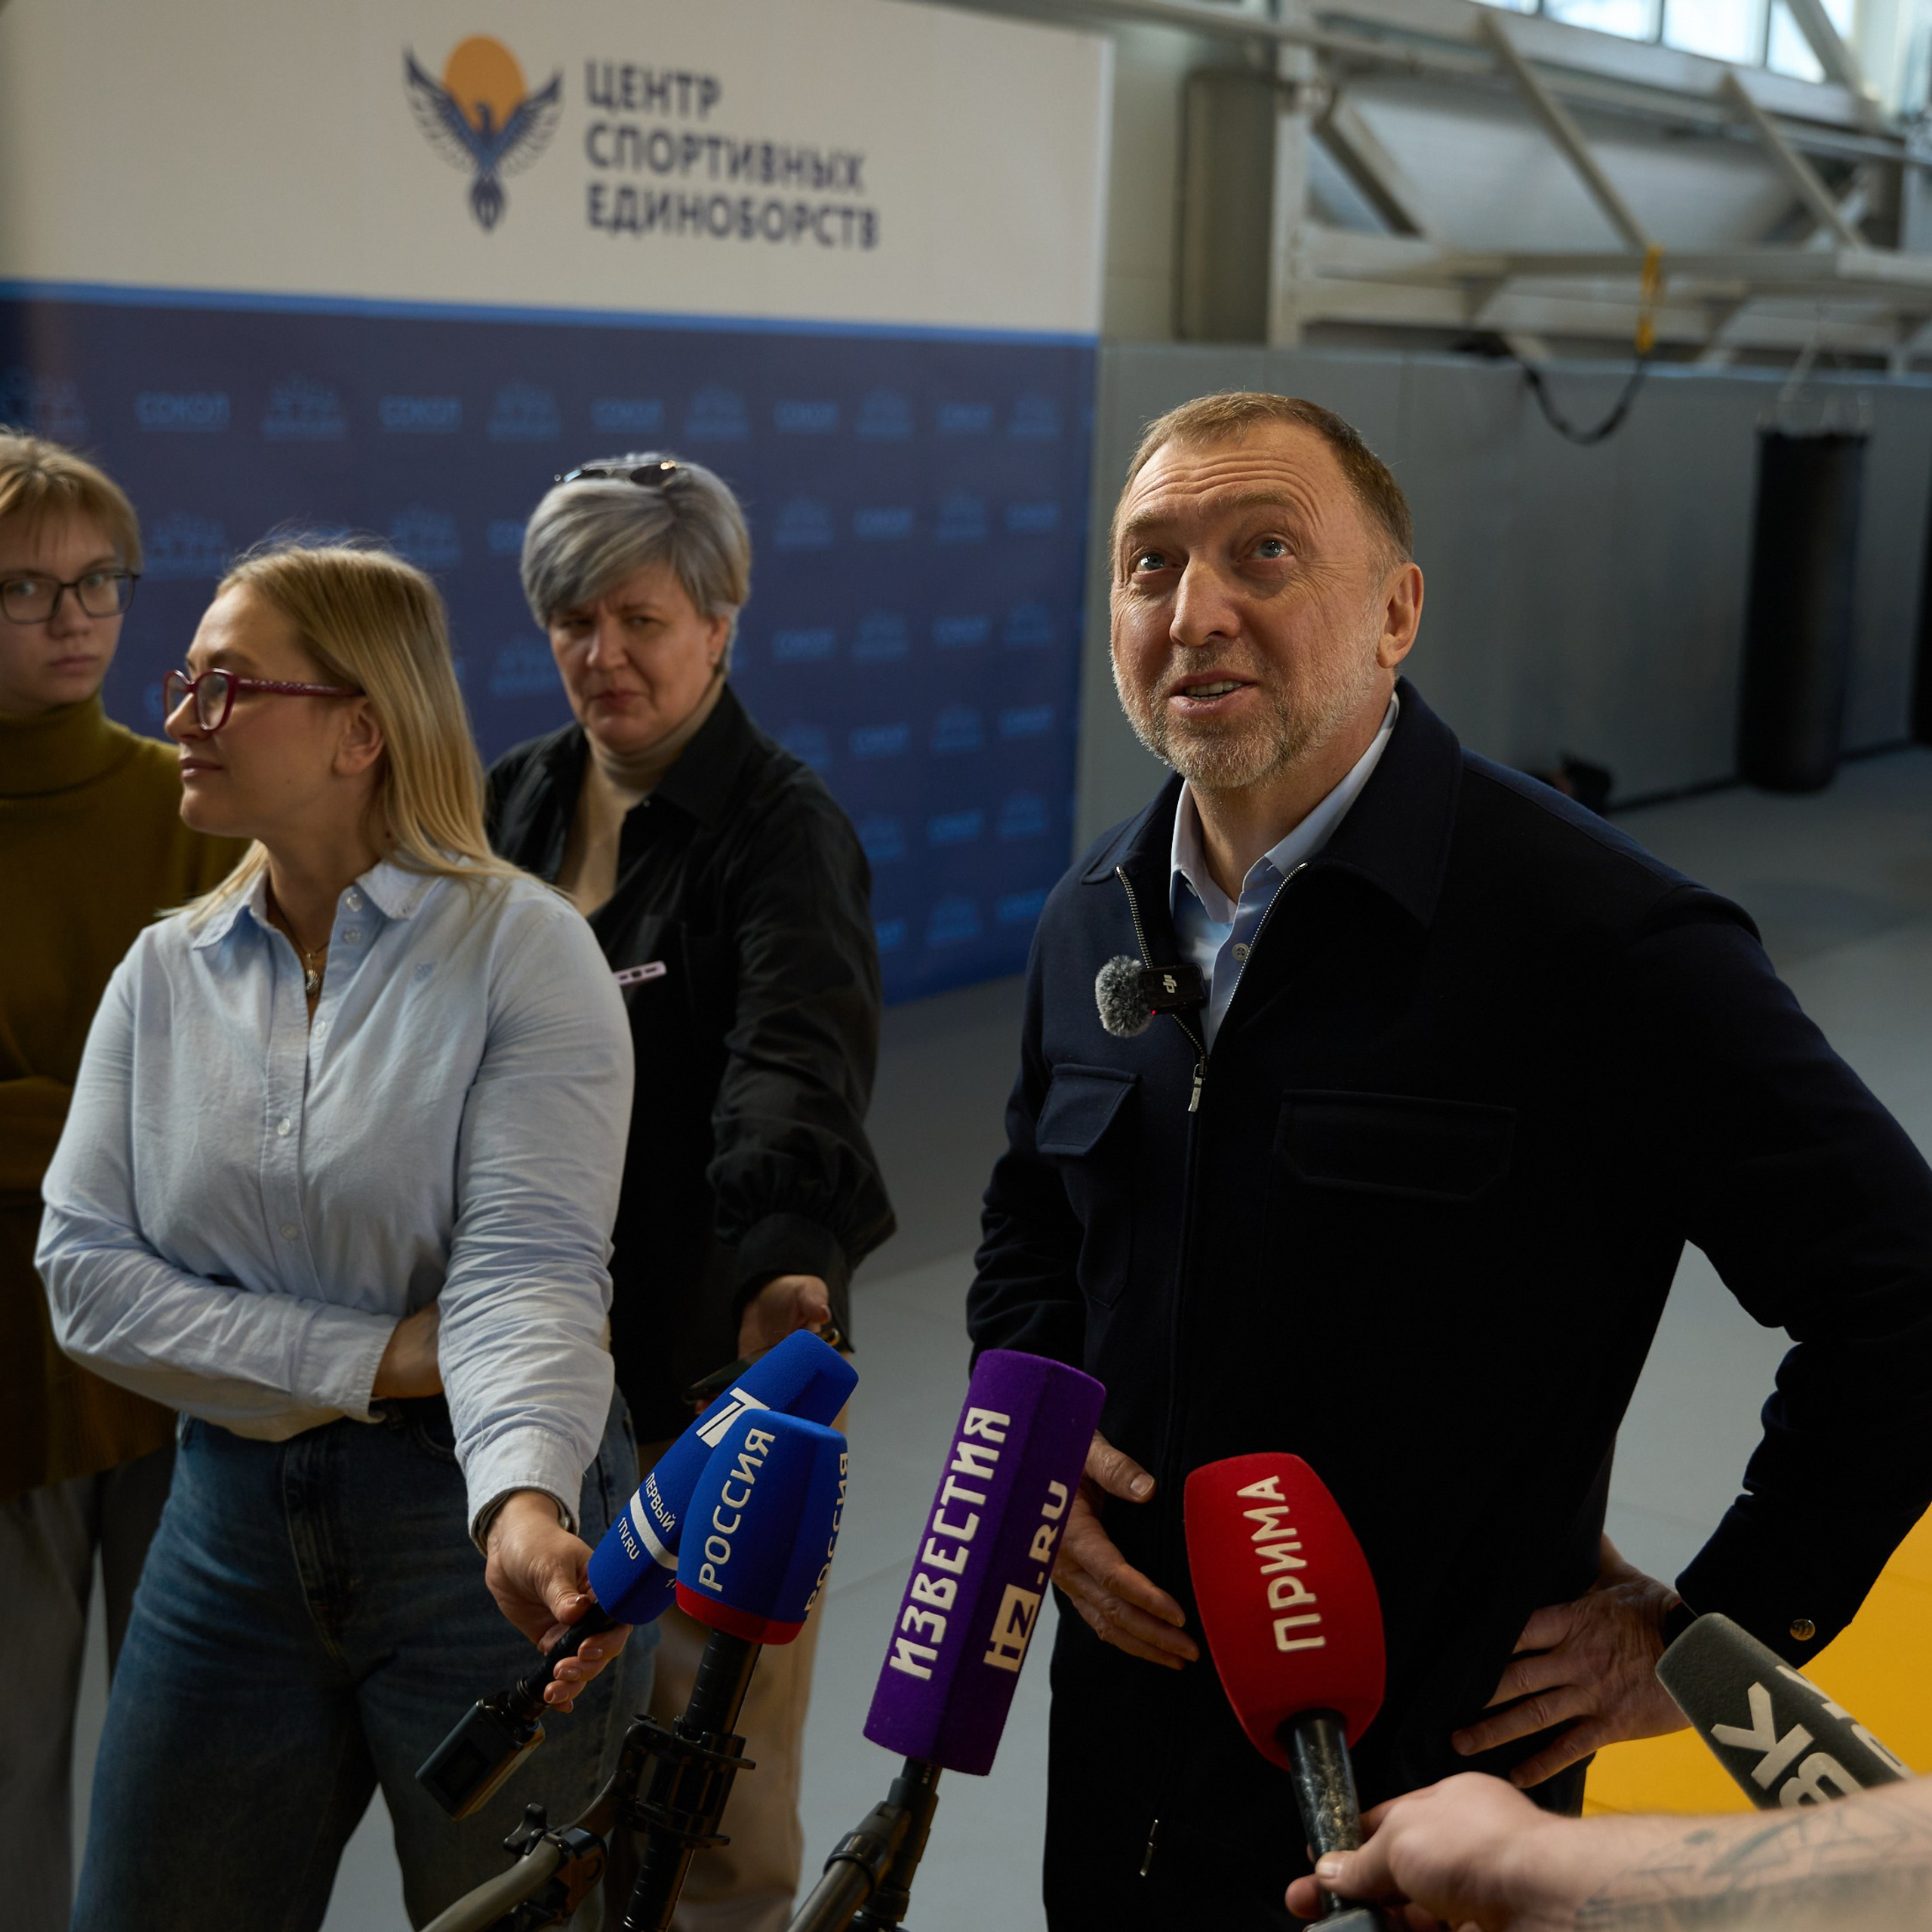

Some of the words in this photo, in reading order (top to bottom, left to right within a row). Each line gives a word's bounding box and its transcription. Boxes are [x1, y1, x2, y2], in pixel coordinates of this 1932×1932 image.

[586, 61, 721, 118] ЦЕНТР
[586, 121, 865, 193] СПОРТИВНЫХ
[587, 183, 878, 250] ЕДИНОБОРСТВ
[645, 1472, 677, 1533] ПЕРВЫЙ
[698, 1428, 776, 1592] РОССИЯ
[617, 1517, 640, 1561] 1TV.RU
[889, 1407, 1011, 1681] ИЗВЕСТИЯ
[1237, 1475, 1326, 1653] ПРИМА
